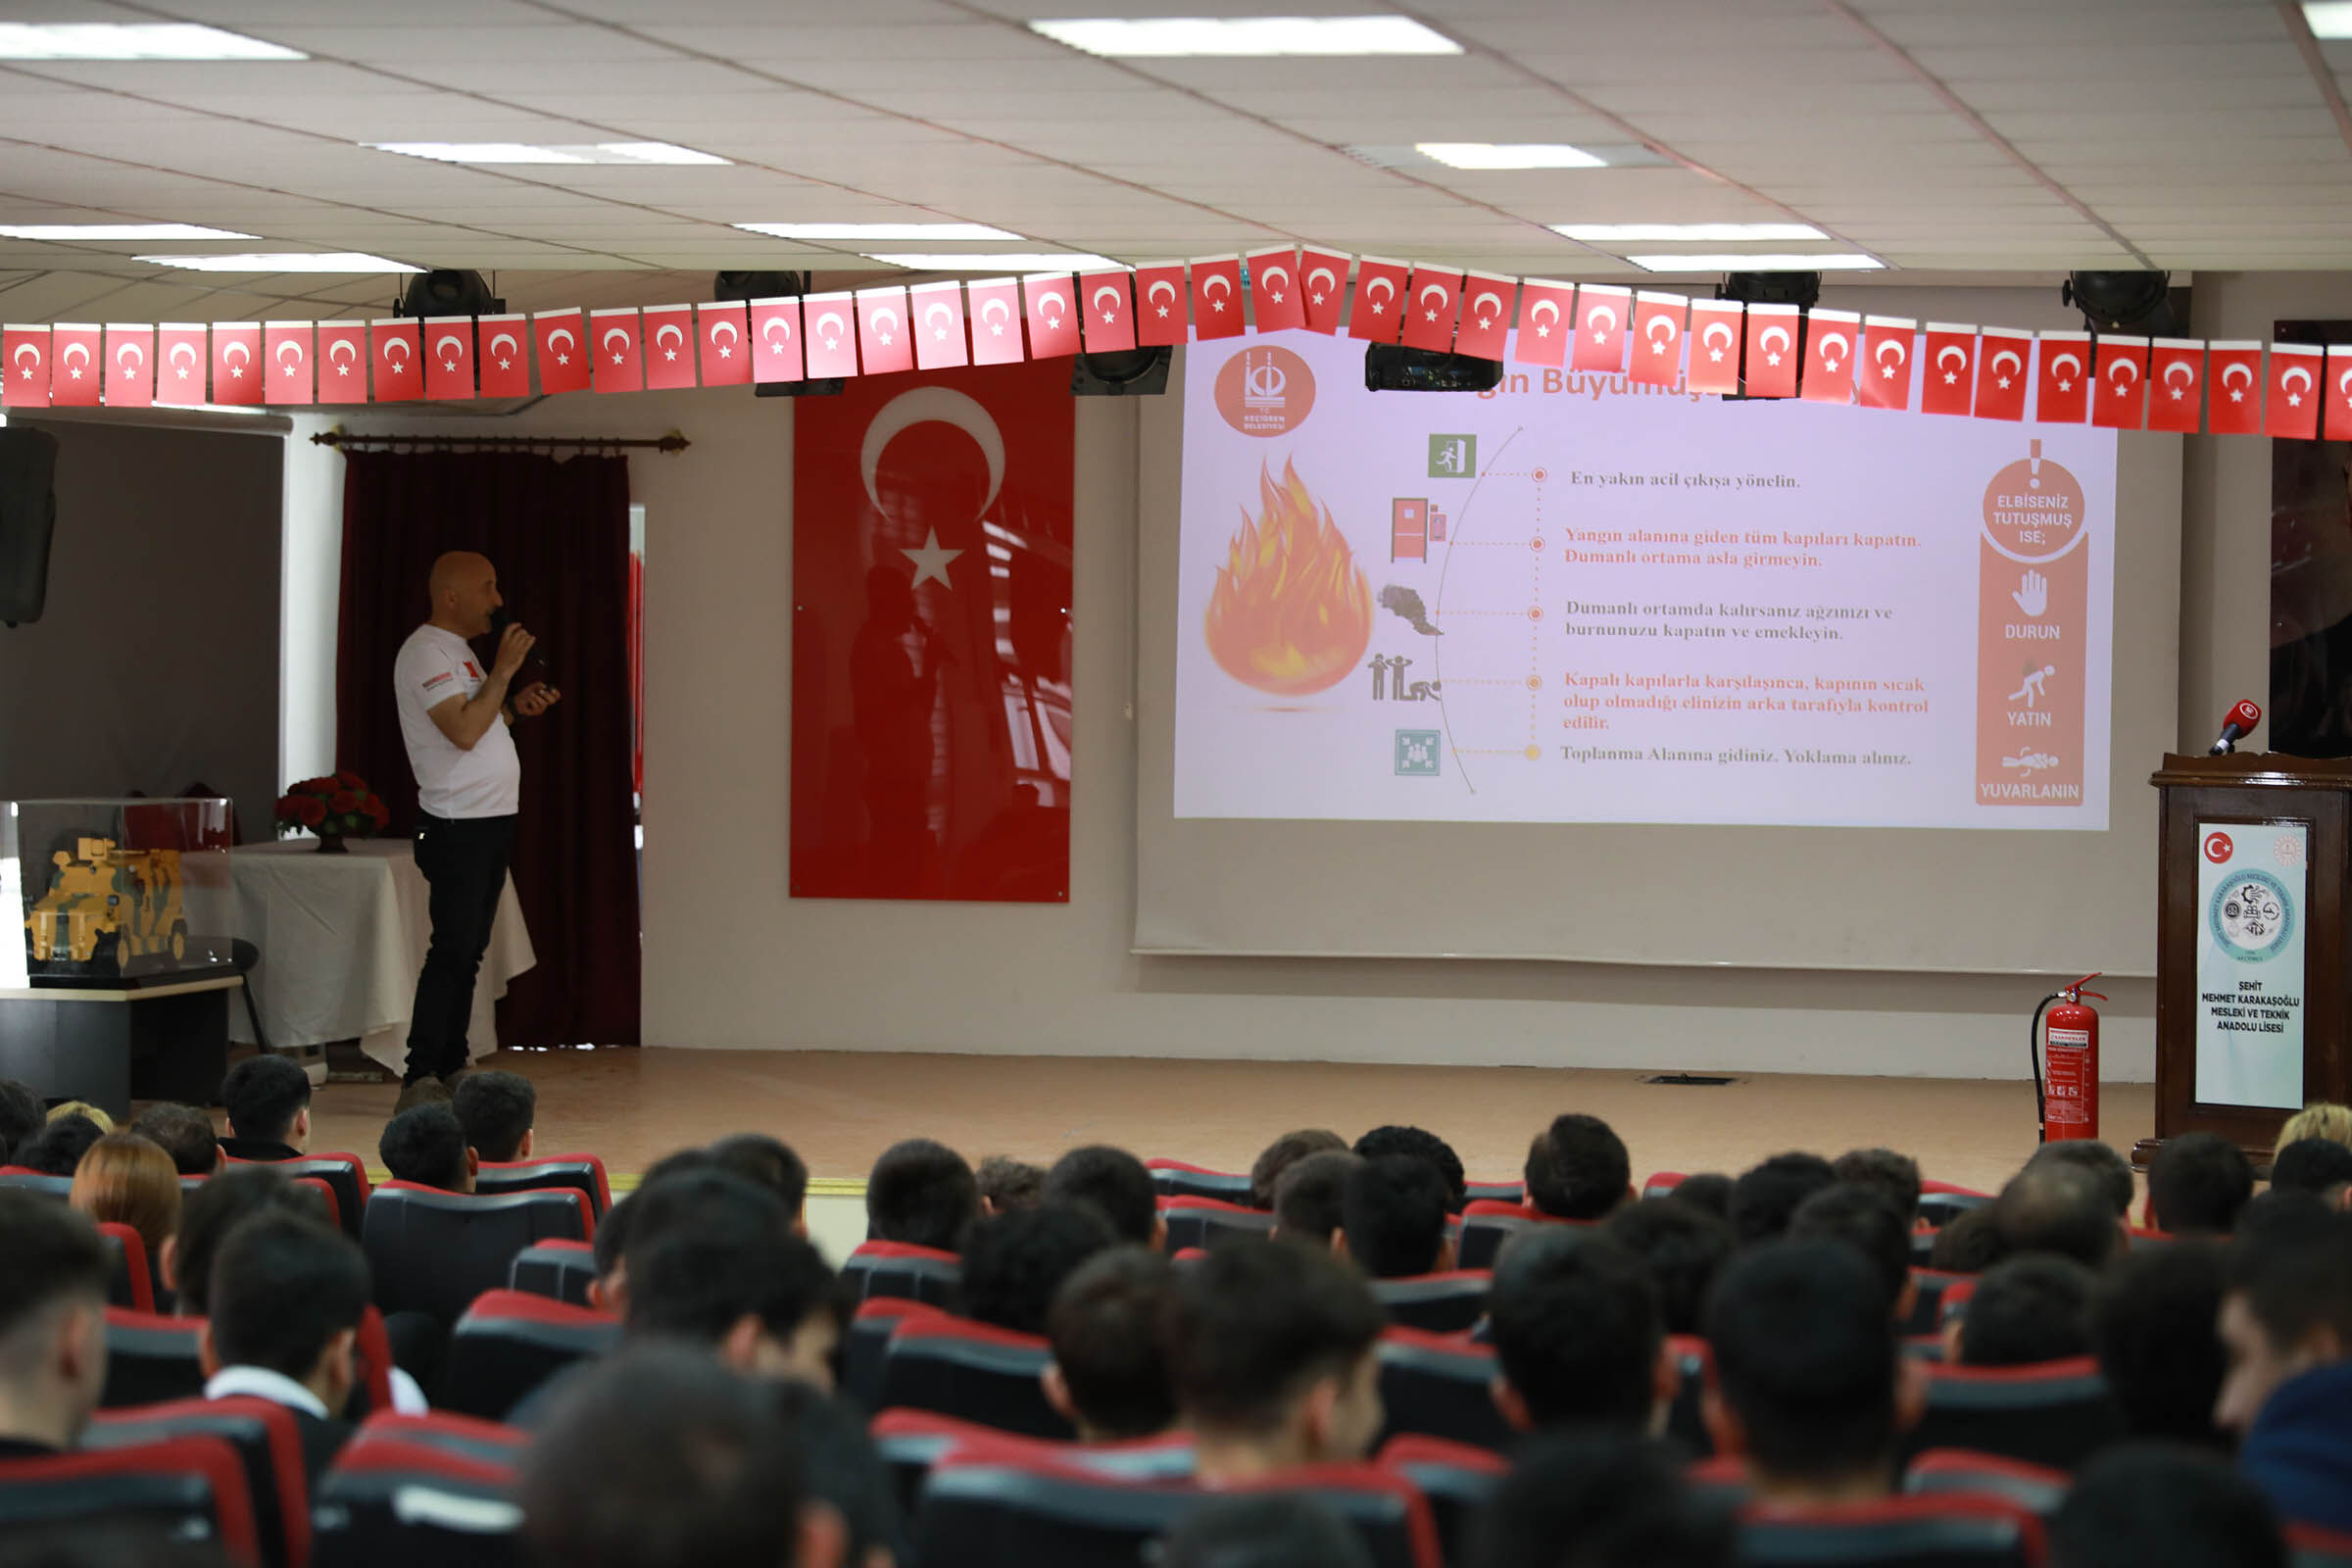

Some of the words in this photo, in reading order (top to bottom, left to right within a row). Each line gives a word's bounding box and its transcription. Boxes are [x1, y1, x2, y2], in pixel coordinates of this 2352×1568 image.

[1571, 471, 1593, 485] En
[1597, 471, 1645, 488] yakın
[1650, 472, 1679, 486] acil
[1684, 473, 1731, 489] çıkışa
[1736, 474, 1800, 490] yönelin.
[1997, 493, 2069, 510] ELBİSENİZ
[1993, 512, 2073, 527] TUTUŞMUŞ
[1566, 527, 1623, 545] Yangın
[1628, 529, 1690, 543] alanına
[1693, 529, 1739, 546] giden
[1744, 530, 1778, 545] tüm
[1783, 532, 1848, 549] kapıları
[1853, 533, 1922, 550] kapatın.
[1564, 549, 1637, 564] Dumanlı
[1641, 551, 1701, 565] ortama
[1707, 551, 1739, 565] asla
[1743, 553, 1823, 568] girmeyin.
[1567, 601, 1639, 615] Dumanlı
[1642, 603, 1713, 616] ortamda
[1719, 603, 1800, 618] kalırsanız
[1805, 605, 1870, 620] ağzınızı
[1875, 609, 1892, 619] ve
[1565, 622, 1658, 637] burnunuzu
[1664, 624, 1726, 640] kapatın
[1733, 627, 1750, 638] ve
[1755, 625, 1842, 642] emekleyin.
[2005, 624, 2061, 640] DURUN
[1564, 672, 1621, 689] Kapalı
[1625, 673, 1700, 690] kapılarla
[1705, 674, 1809, 691] karşılaşınca,
[1815, 676, 1877, 693] kapının
[1883, 678, 1925, 691] sıcak
[1564, 695, 1600, 710] olup
[1605, 695, 1677, 711] olmadığı
[1683, 696, 1741, 710] elinizin
[1747, 698, 1787, 711] arka
[1791, 699, 1862, 714] tarafıyla
[1867, 700, 1929, 713] kontrol
[1563, 715, 1610, 730] edilir.
[2007, 711, 2052, 726] YATIN
[1560, 746, 1643, 762] Toplanma
[1648, 748, 1713, 762] Alanına
[1718, 749, 1778, 764] gidiniz.
[1784, 749, 1856, 764] Yoklama
[1862, 751, 1912, 764] alınız.
[1982, 783, 2080, 799] YUVARLANIN
[2238, 980, 2262, 992] ŞEHİT
[2202, 994, 2236, 1004] MEHMET
[2237, 994, 2299, 1007] KARAKAŞOĞLU
[2211, 1006, 2246, 1017] MESLEKİ
[2248, 1008, 2259, 1018] VE
[2261, 1007, 2289, 1020] TEKNİK
[2217, 1021, 2258, 1032] ANADOLU
[2259, 1021, 2283, 1033] LİSESİ
